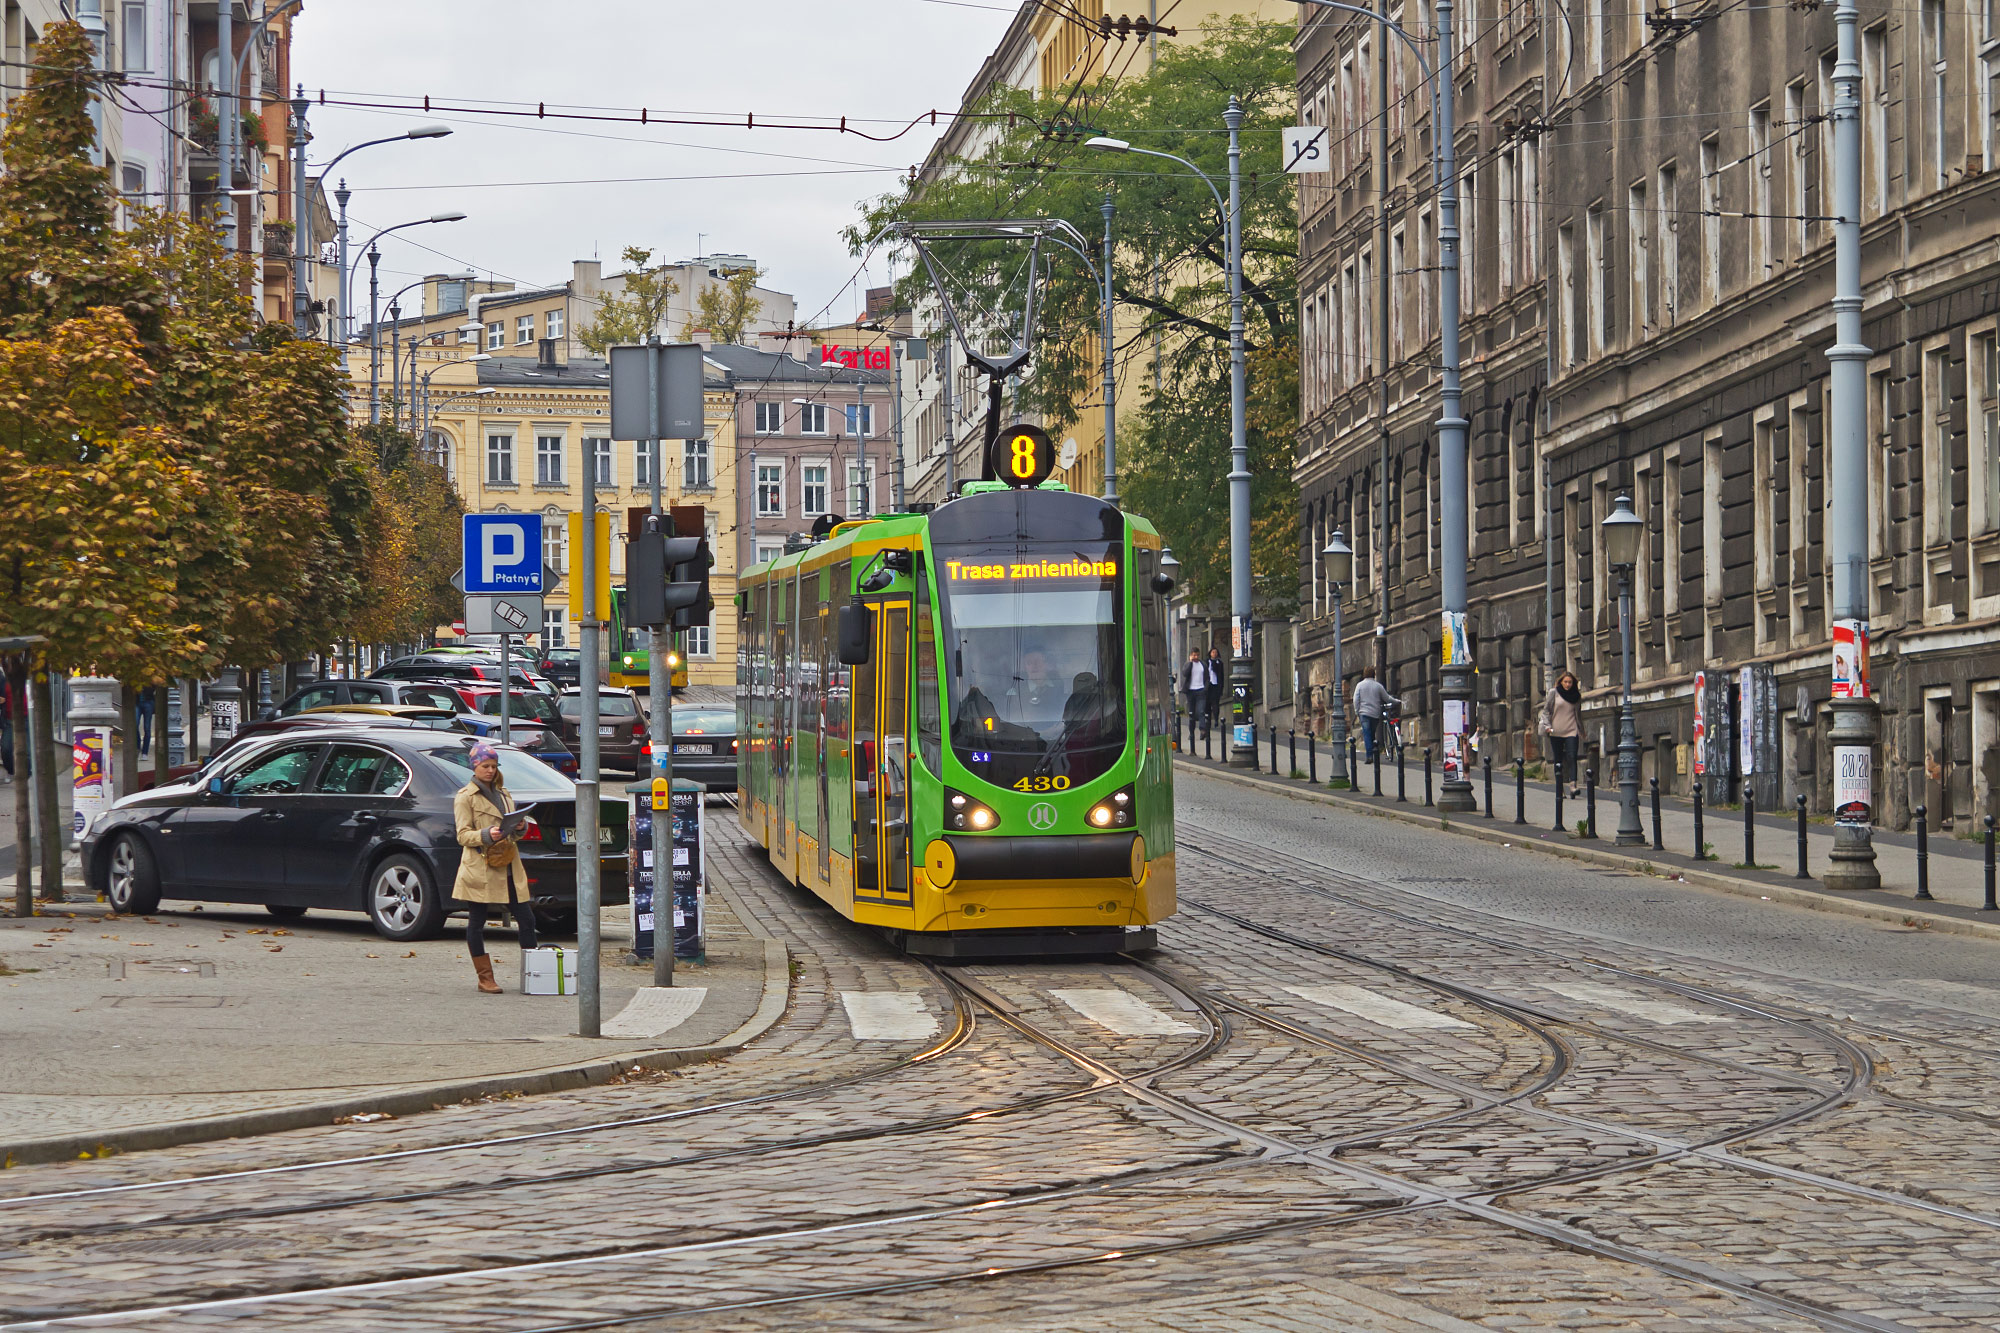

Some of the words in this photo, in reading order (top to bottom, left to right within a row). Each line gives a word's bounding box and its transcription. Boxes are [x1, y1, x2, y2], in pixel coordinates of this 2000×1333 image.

[1292, 140, 1320, 160] 15
[822, 344, 890, 369] Kartel
[1011, 435, 1036, 478] 8
[481, 523, 525, 584] P
[495, 573, 530, 586] Płatny
[946, 561, 1005, 580] Trasa
[1010, 559, 1117, 578] zmieniona
[984, 717, 994, 731] 1
[1013, 775, 1071, 792] 430
